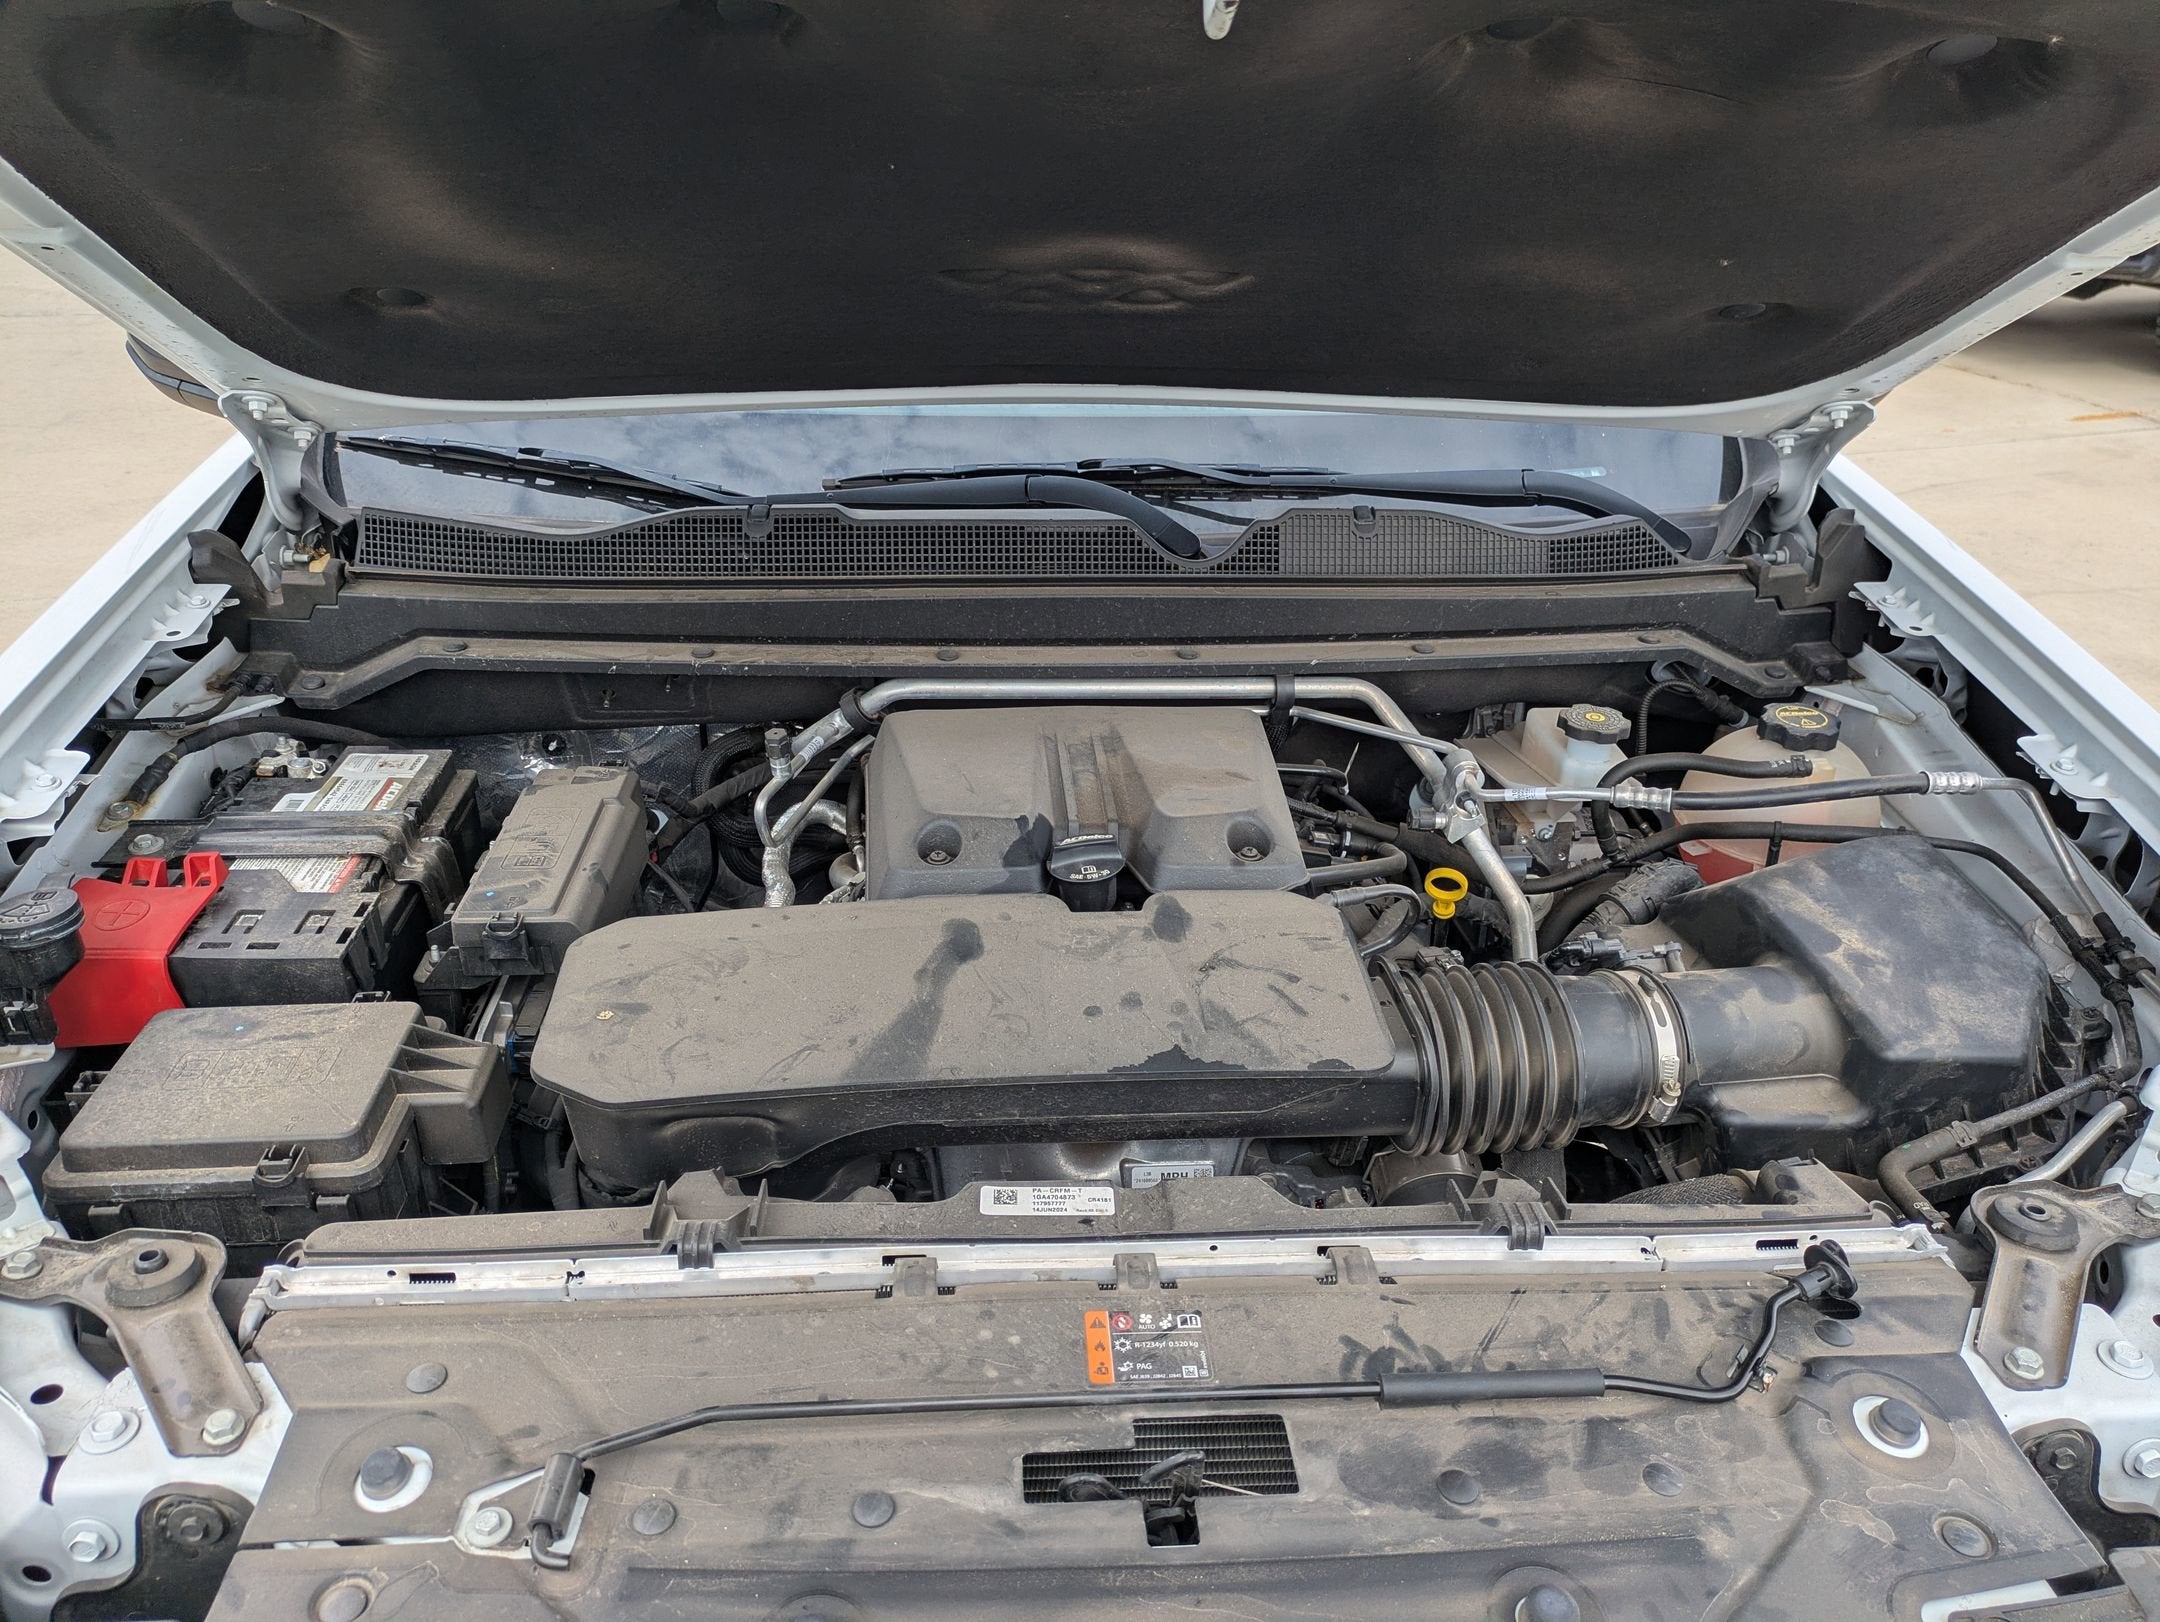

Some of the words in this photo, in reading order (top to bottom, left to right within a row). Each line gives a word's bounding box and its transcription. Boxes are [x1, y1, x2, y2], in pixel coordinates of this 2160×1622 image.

[1134, 1341, 1166, 1349] R-1234yf
[1168, 1340, 1188, 1348] 0.520
[1189, 1340, 1199, 1349] kg
[1136, 1362, 1153, 1370] PAG
